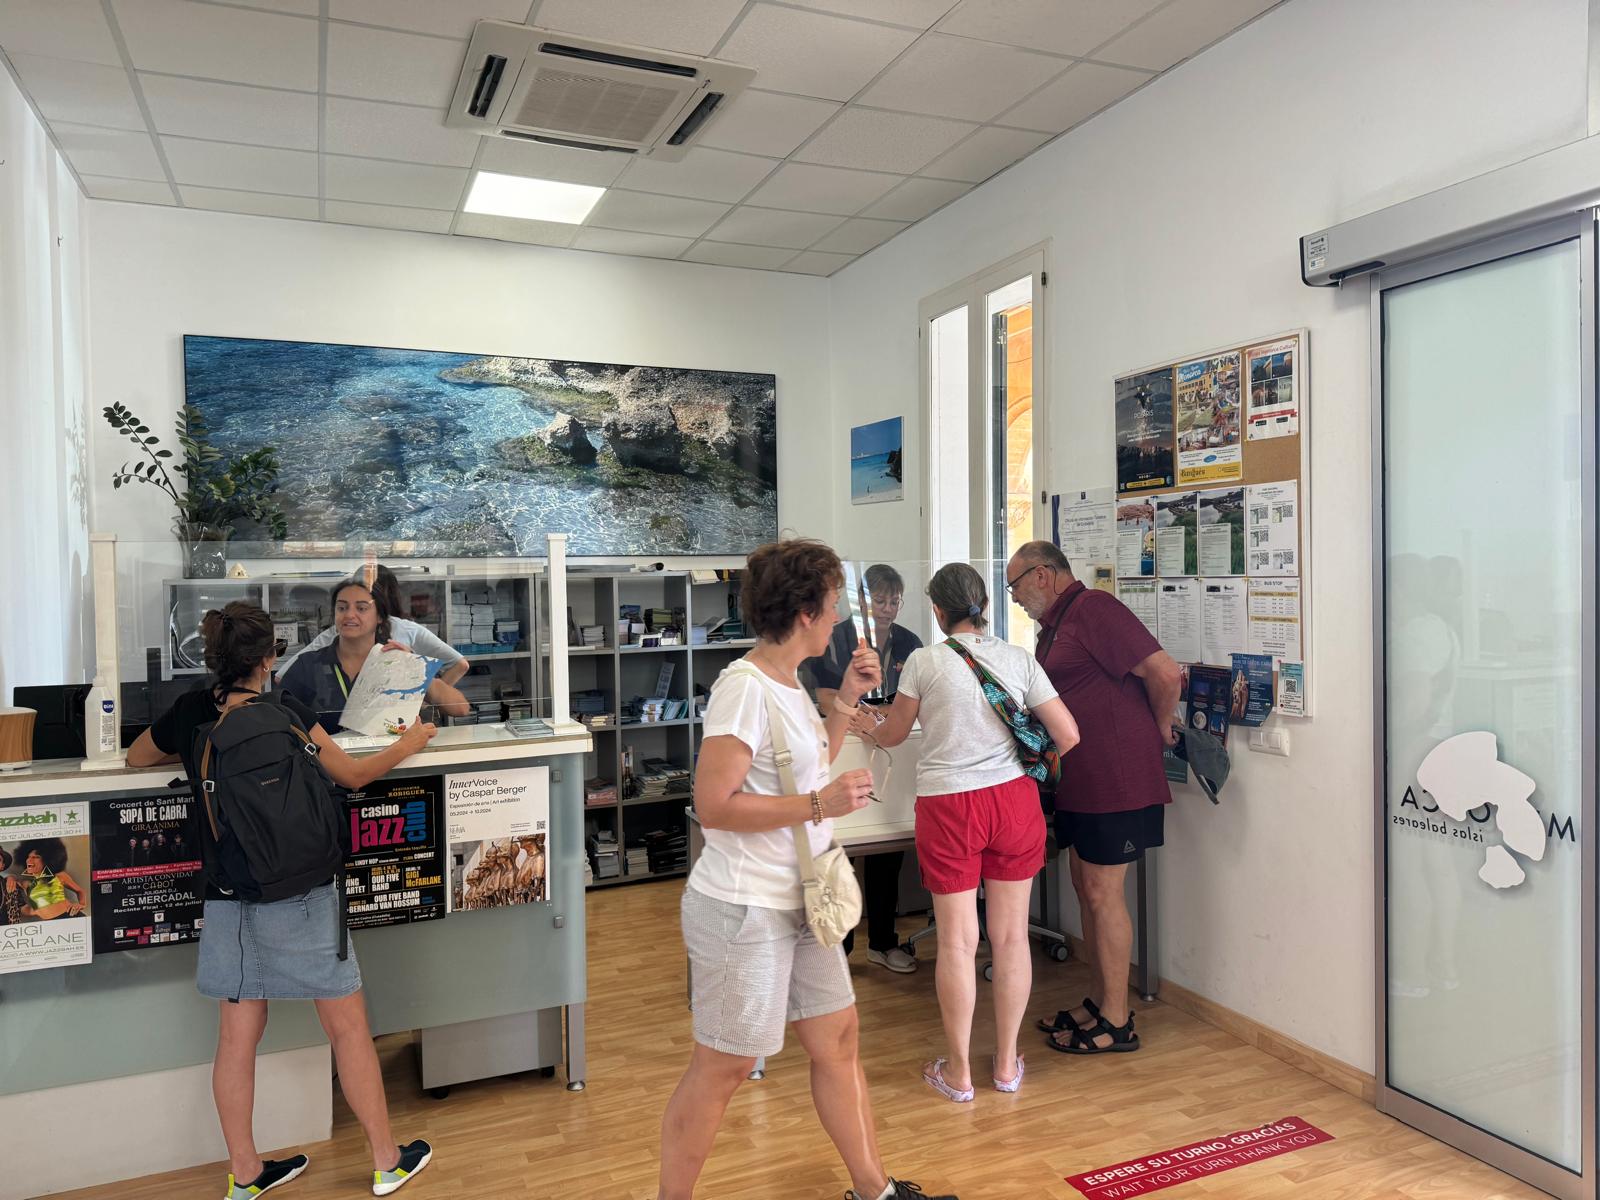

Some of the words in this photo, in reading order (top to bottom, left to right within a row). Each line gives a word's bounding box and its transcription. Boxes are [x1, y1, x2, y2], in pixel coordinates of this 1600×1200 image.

[449, 791, 461, 801] by
[462, 788, 495, 798] Caspar
[497, 785, 527, 796] Berger
[109, 801, 142, 809] Concert
[156, 797, 175, 806] Sant
[176, 796, 195, 804] Mart
[120, 807, 143, 824] SOPA
[146, 806, 157, 822] DE
[159, 804, 188, 821] CABRA
[361, 804, 400, 818] casino
[131, 823, 152, 832] GIRA
[401, 800, 427, 842] club
[350, 807, 406, 854] jazz
[413, 851, 435, 860] CONCERT
[121, 875, 154, 885] ARTISTA
[154, 871, 194, 880] CONVIDAT
[371, 875, 385, 884] OUR
[386, 873, 400, 882] FIVE
[405, 870, 419, 879] GIGI
[405, 875, 442, 888] McFARLANE
[345, 885, 366, 895] ARTET
[371, 882, 390, 892] BAND
[121, 898, 136, 907] ES
[138, 891, 196, 904] MERCADAL
[373, 893, 388, 903] OUR
[388, 892, 402, 901] FIVE
[402, 890, 420, 899] BAND
[379, 900, 393, 910] VAN
[393, 897, 421, 908] ROSSUM
[4, 924, 43, 939] GIGI
[0, 932, 84, 951] ARLANE
[1083, 1163, 1149, 1186] ESPERE
[1147, 1156, 1171, 1168] SU
[1170, 1142, 1233, 1161] TURNO,
[1230, 1122, 1297, 1145] GRACIAS
[1102, 1181, 1145, 1198] WAIT
[1145, 1168, 1193, 1186] YOUR
[1190, 1156, 1238, 1173] TURN,
[1234, 1141, 1287, 1161] THANK
[1284, 1132, 1317, 1146] YOU
